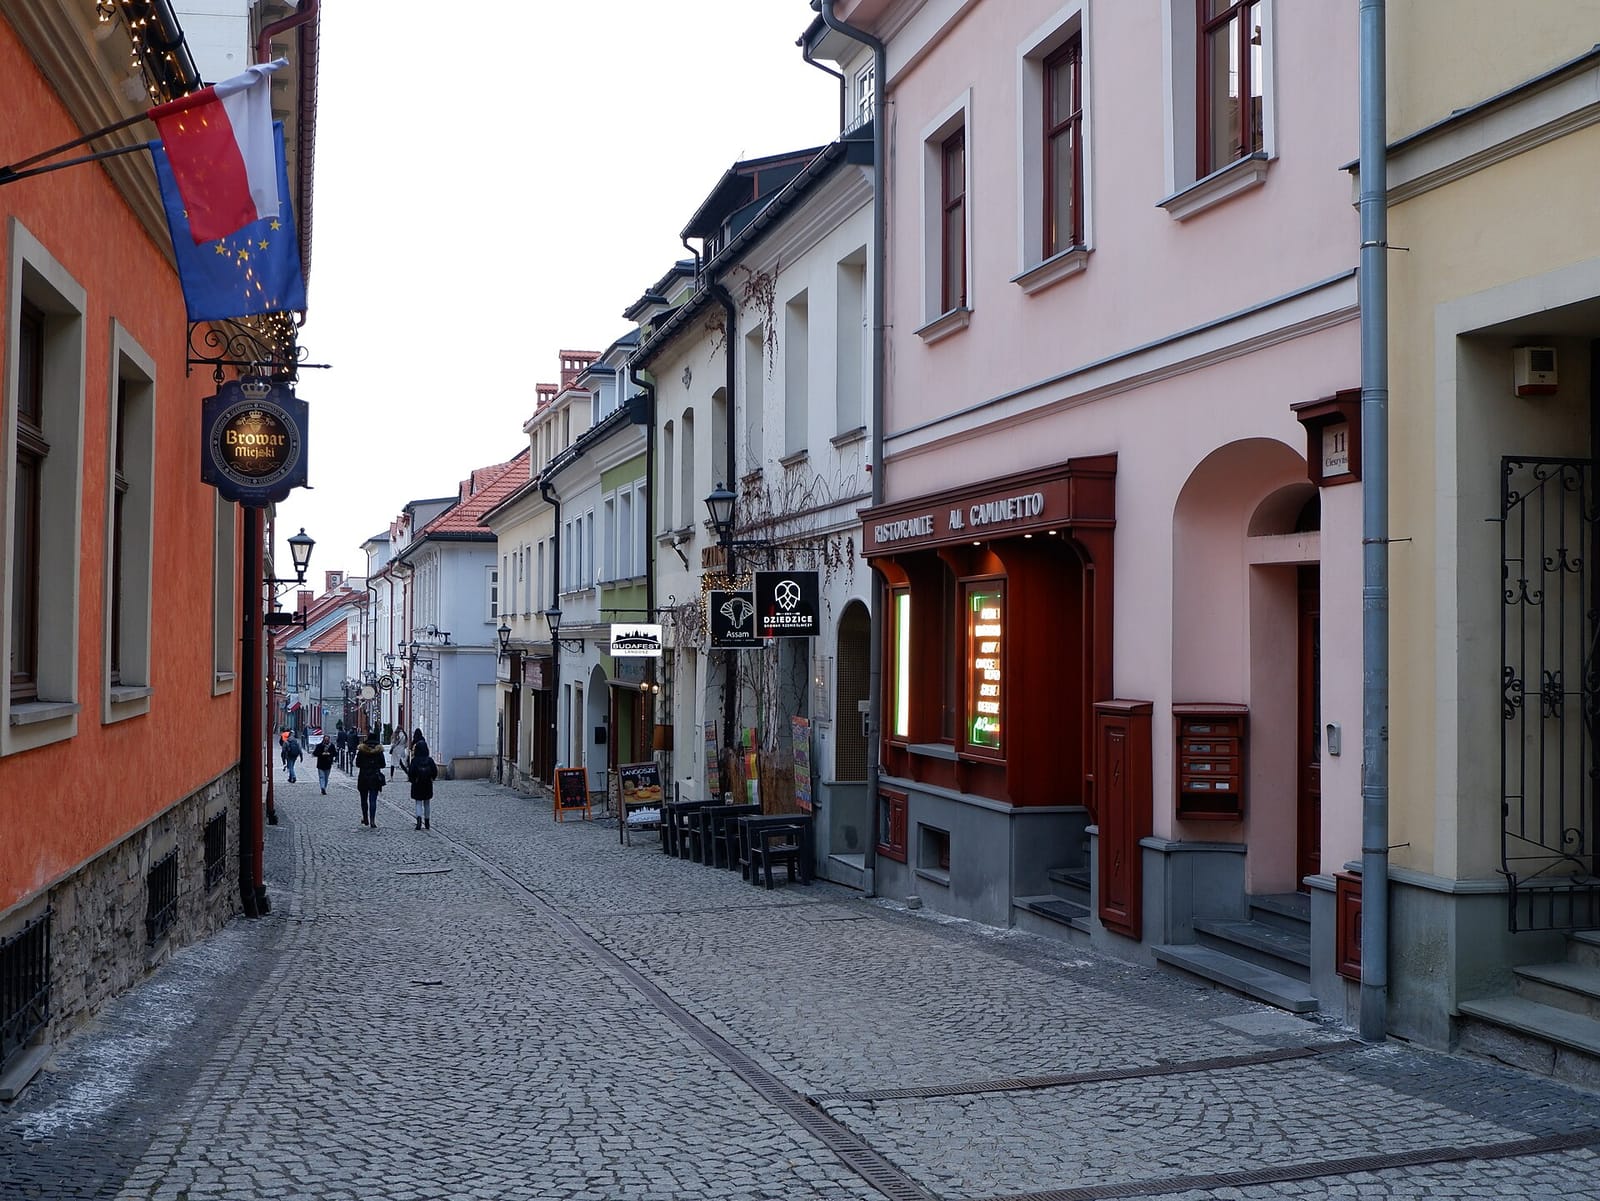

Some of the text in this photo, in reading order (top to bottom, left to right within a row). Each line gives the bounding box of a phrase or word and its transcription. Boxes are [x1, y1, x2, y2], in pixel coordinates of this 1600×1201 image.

[226, 430, 286, 446] Browar
[1334, 432, 1345, 453] 11
[235, 446, 275, 459] Miejski
[874, 492, 1044, 544] RISTORANTE AL CAMINETTO
[726, 630, 750, 638] Assam
